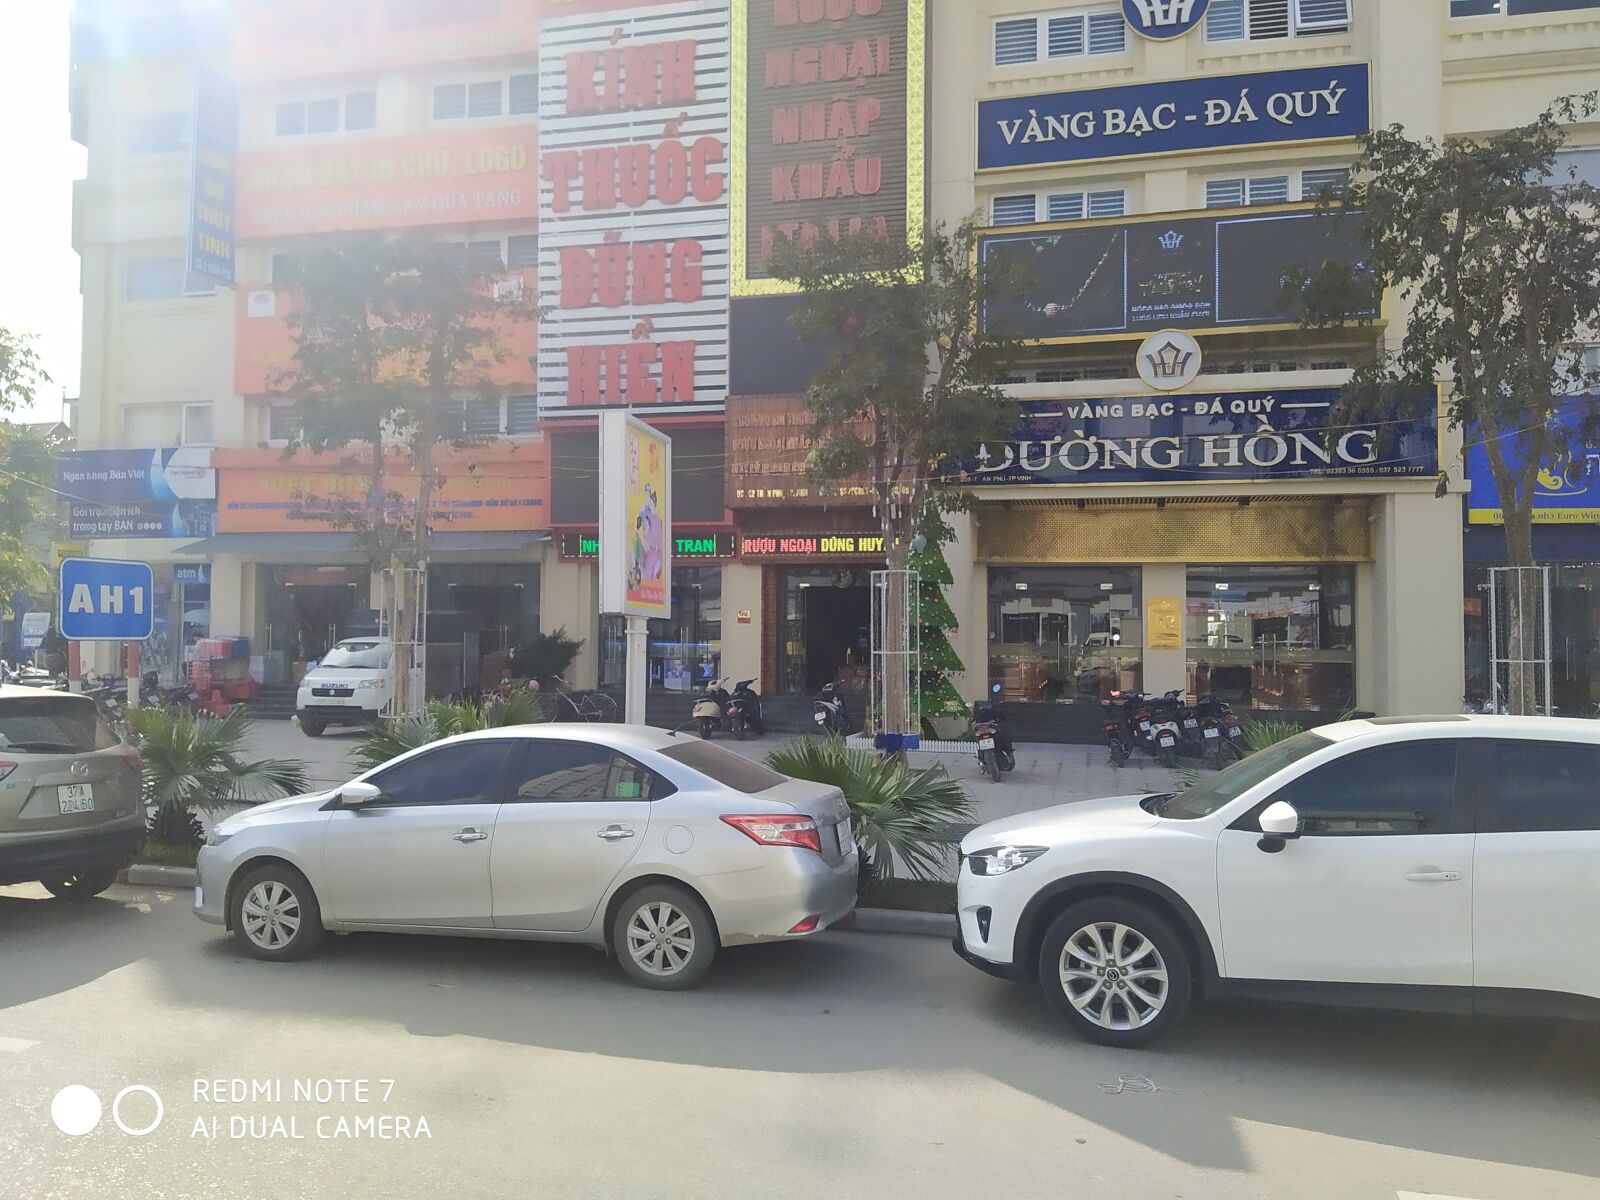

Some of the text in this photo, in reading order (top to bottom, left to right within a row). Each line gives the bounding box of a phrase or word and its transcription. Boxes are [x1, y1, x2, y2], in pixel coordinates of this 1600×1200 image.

[564, 27, 698, 115] KÍNH
[765, 35, 891, 89] NGOẠI
[771, 92, 881, 146] NHẬP
[996, 80, 1347, 146] VÀNG BẠC - ĐÁ QUÝ
[465, 144, 527, 174] LOGO
[541, 111, 725, 213] THUỐC
[770, 140, 882, 203] KHẨU
[558, 229, 704, 310] DŨNG
[565, 315, 697, 408] HIỀN
[1066, 401, 1124, 420] VÀNG
[1131, 402, 1175, 420] BẠC
[1194, 397, 1224, 416] ĐÁ
[1229, 393, 1276, 418] QUÝ
[975, 413, 1379, 472] ĐƯỜNG HỒNG
[73, 521, 97, 534] trong
[98, 521, 113, 533] tay
[744, 537, 776, 555] RƯỢU
[780, 538, 817, 555] NGOẠI
[820, 535, 855, 553] DŨNG
[67, 583, 144, 615] AH1
[177, 567, 196, 579] atm
